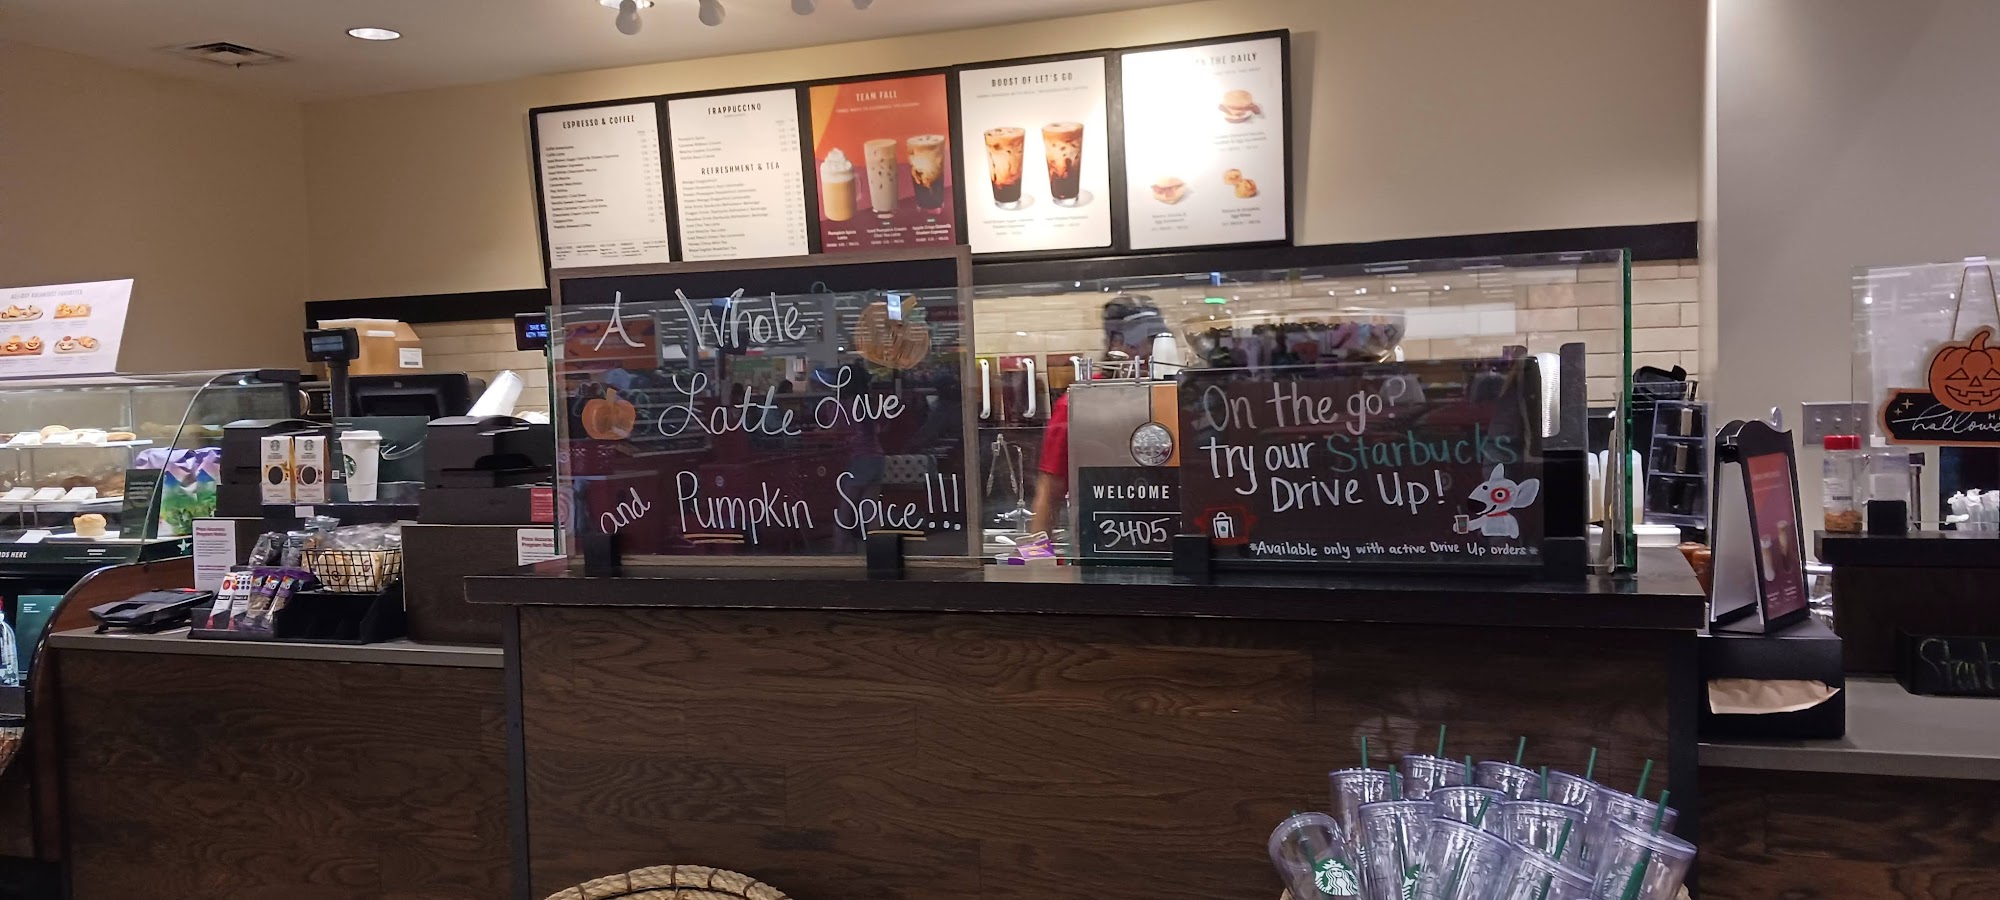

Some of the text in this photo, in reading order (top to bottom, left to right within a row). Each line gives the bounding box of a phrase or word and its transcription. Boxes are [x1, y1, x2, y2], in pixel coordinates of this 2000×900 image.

[1210, 55, 1227, 65] THE
[1231, 51, 1258, 63] DAILY
[991, 72, 1073, 88] BOOST OF LET'S GO
[856, 90, 897, 102] TEAM FALL
[707, 102, 762, 115] FRAPPUCCINO
[562, 114, 635, 129] ESPRESSO & COFFEE
[701, 162, 780, 175] REFRESHMENT & TEA
[594, 287, 807, 352] A Whole
[657, 365, 906, 437] Latte Love
[1202, 376, 1407, 436] On the go?
[1199, 423, 1519, 496] try our Starbucks
[1093, 484, 1170, 500] WELCOME
[1270, 469, 1446, 515] Drive Up!
[600, 469, 962, 545] and Pumpkin Spice!!!
[1099, 516, 1171, 549] 3405
[10, 551, 28, 559] HERE
[1323, 544, 1351, 560] only
[1356, 540, 1386, 556] with
[1389, 543, 1427, 556] active
[1430, 540, 1461, 554] Drive
[1467, 543, 1487, 558] Up
